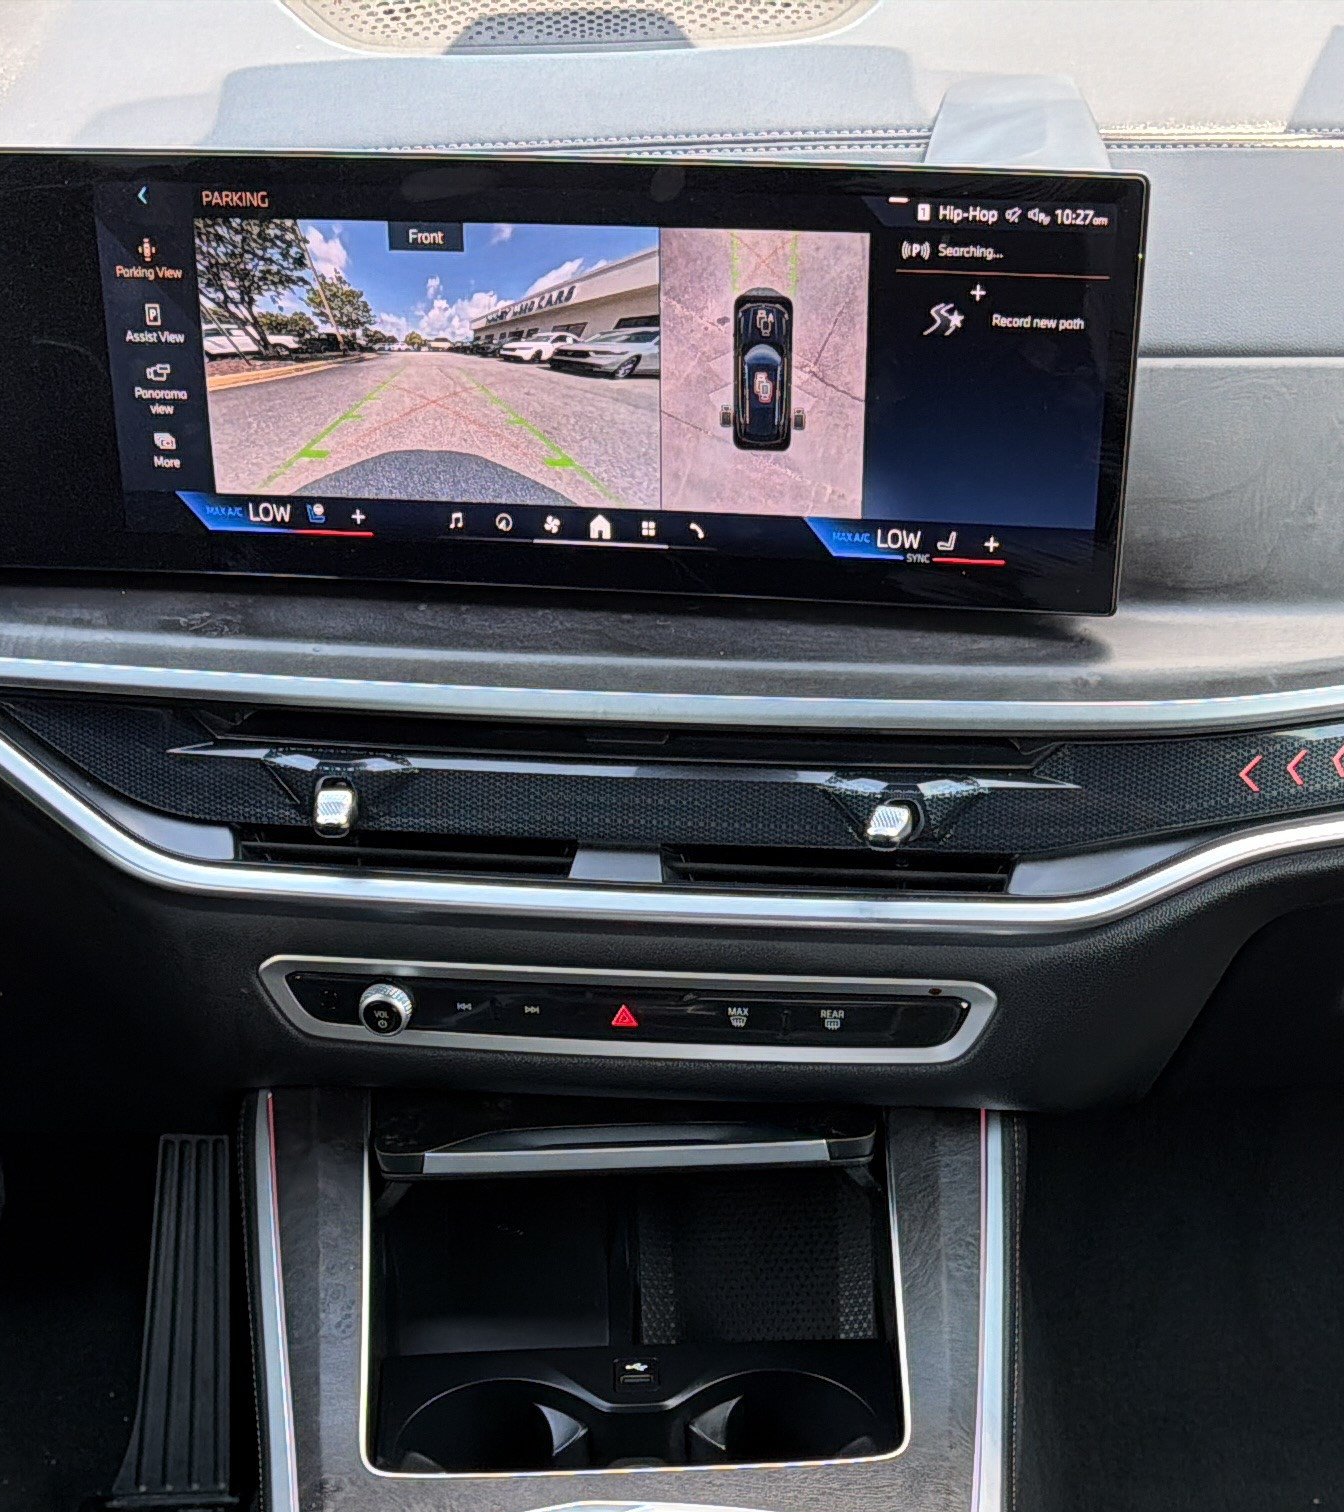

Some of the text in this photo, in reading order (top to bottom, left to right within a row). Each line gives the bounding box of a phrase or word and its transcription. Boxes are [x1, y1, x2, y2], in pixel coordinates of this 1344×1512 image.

[202, 191, 269, 207] PARKING
[939, 205, 998, 224] Hip-Hop
[408, 228, 445, 245] Front
[116, 265, 183, 281] Parking View
[992, 313, 1084, 331] Record new path
[125, 330, 185, 343] Assist View
[134, 386, 188, 400] Panorama
[150, 403, 174, 415] view
[154, 455, 181, 468] More
[248, 502, 291, 522] LOW
[877, 528, 921, 550] LOW
[906, 553, 931, 564] SYNC
[374, 1010, 389, 1019] VOL
[727, 1007, 749, 1016] MAX
[820, 1009, 845, 1019] REAR
